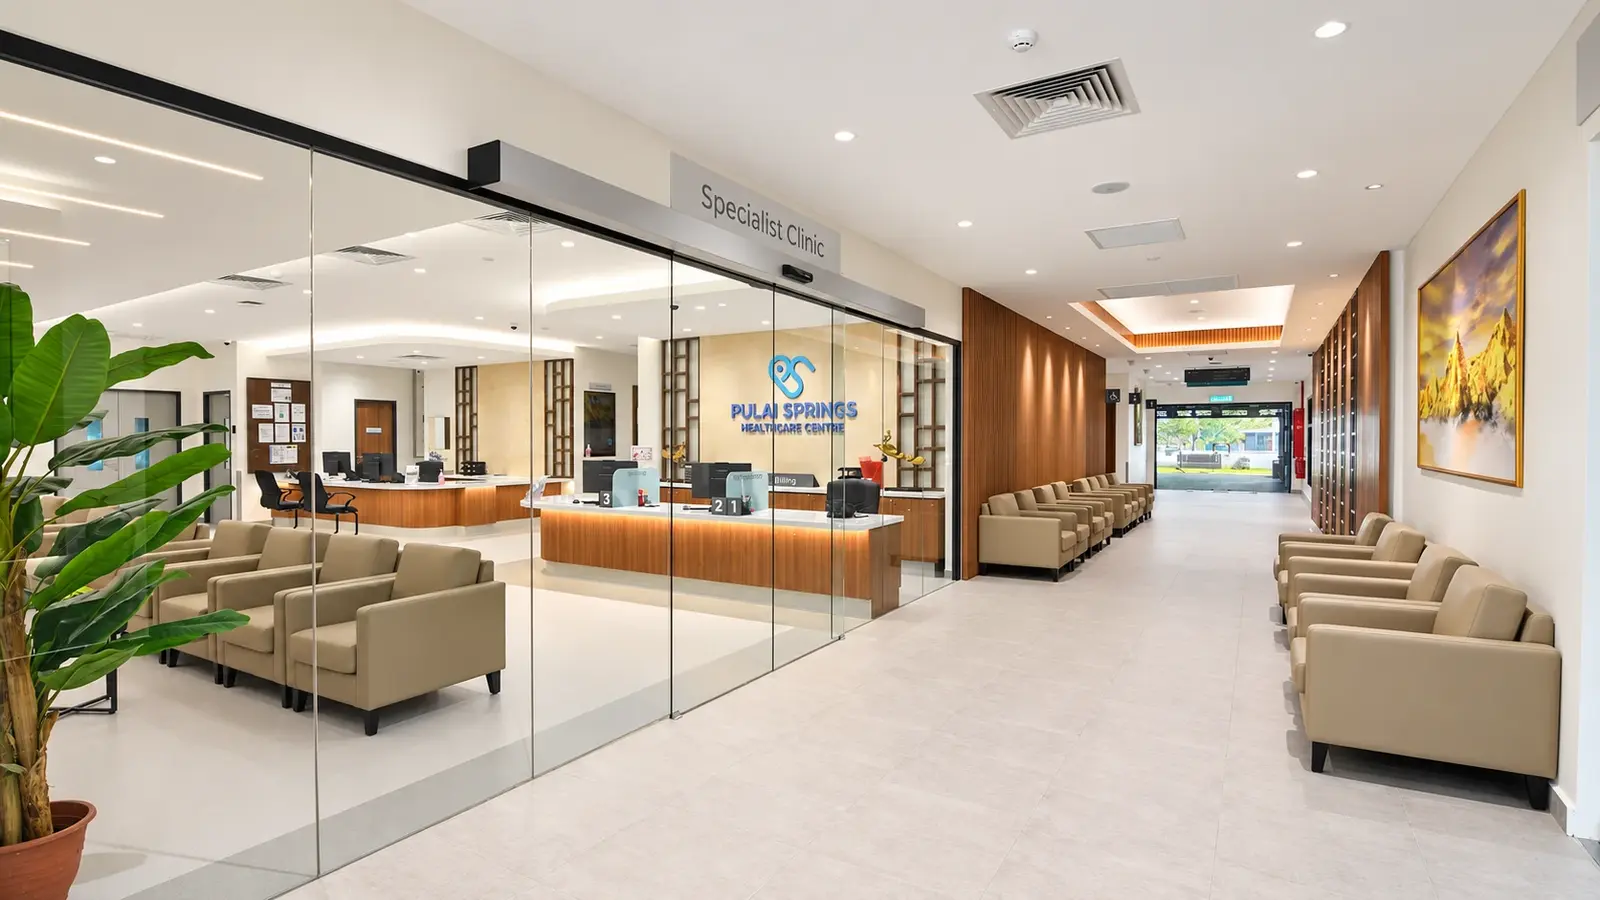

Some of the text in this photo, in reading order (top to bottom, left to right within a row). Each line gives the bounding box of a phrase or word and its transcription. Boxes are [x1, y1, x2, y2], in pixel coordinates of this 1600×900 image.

[701, 183, 825, 258] Specialist Clinic
[731, 401, 858, 420] PULAI SPRINGS
[741, 423, 845, 434] HEALTHCARE CENTRE
[774, 476, 797, 486] Billing
[603, 493, 610, 505] 3
[714, 499, 723, 512] 2
[731, 500, 737, 513] 1
